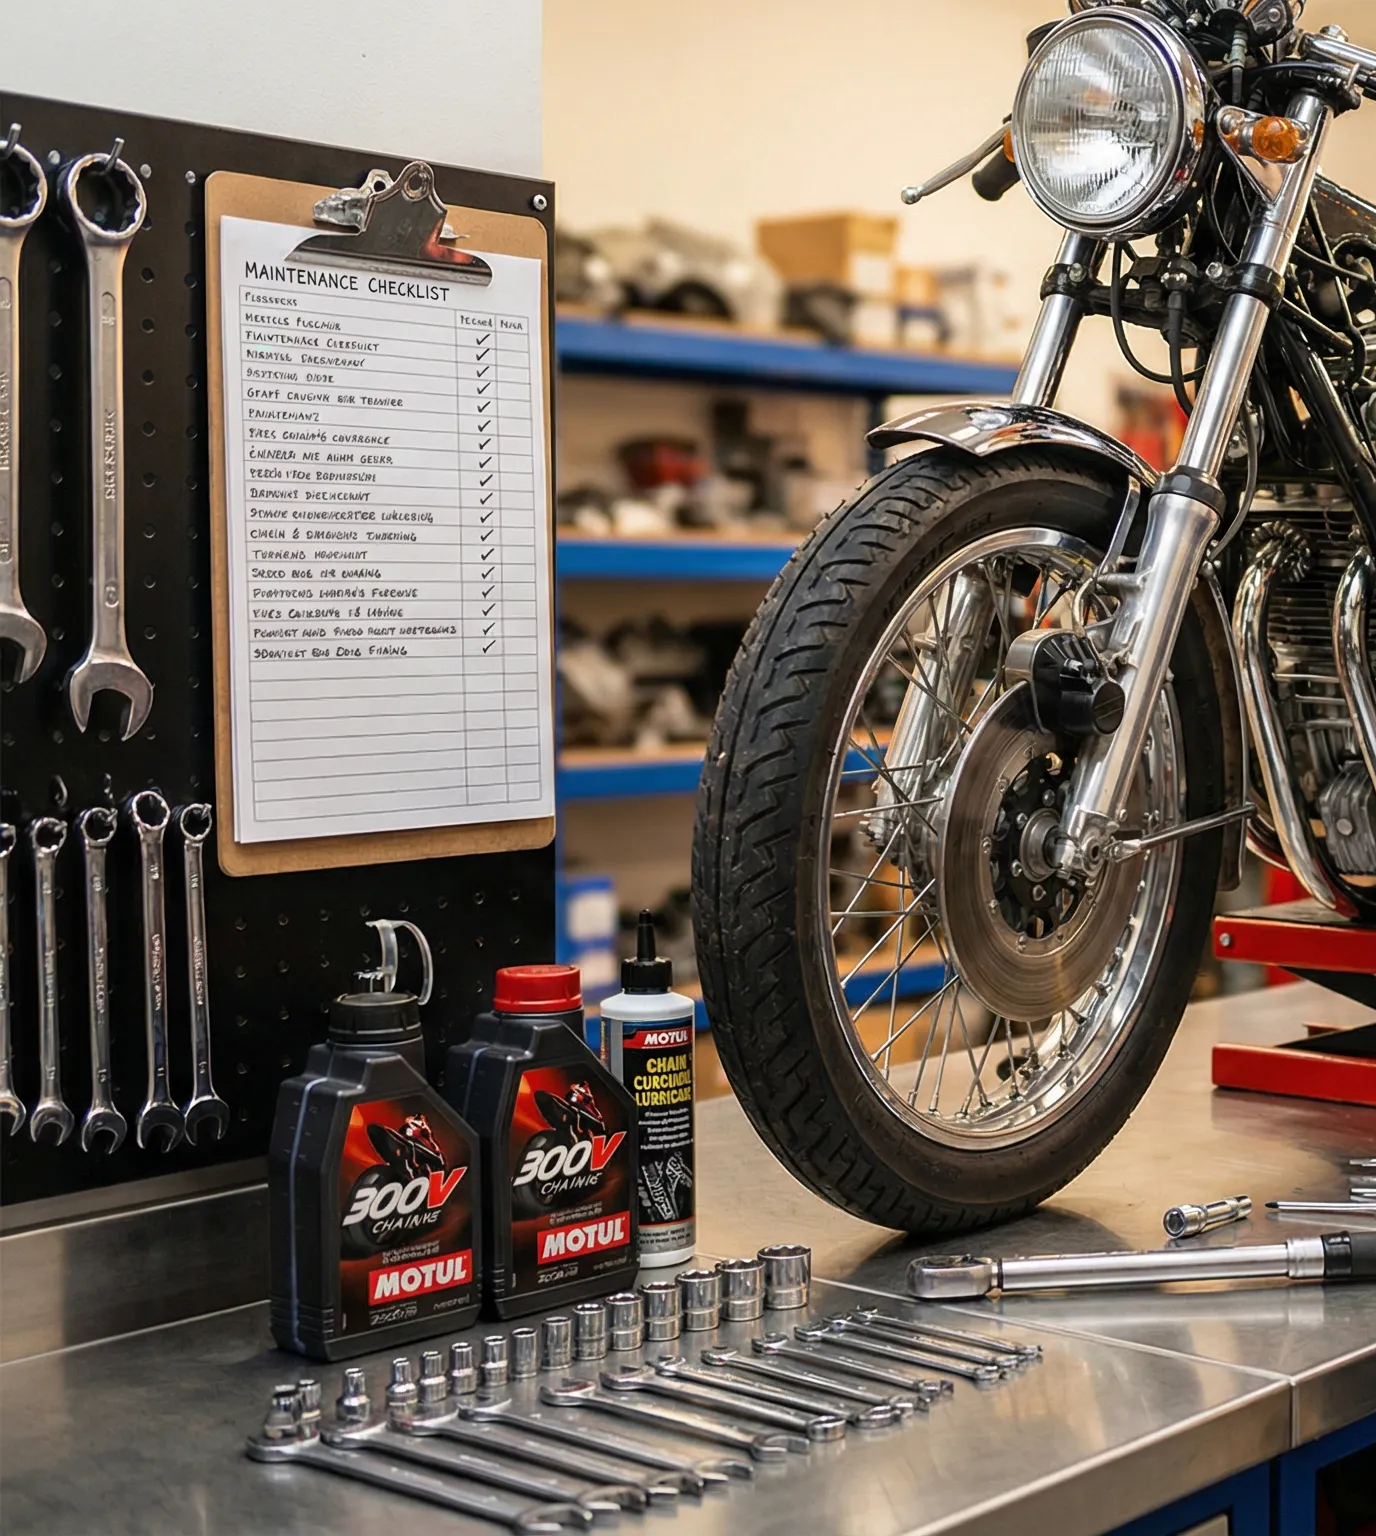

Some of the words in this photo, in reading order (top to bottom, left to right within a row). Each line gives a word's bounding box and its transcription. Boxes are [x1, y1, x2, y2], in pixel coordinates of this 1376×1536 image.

[245, 261, 359, 291] MAINTENANCE
[368, 277, 450, 301] CHECKLIST
[646, 1054, 687, 1073] CHAIN
[512, 1131, 627, 1187] 300V
[342, 1166, 468, 1226] 300V
[542, 1217, 624, 1259] MOTUL
[373, 1256, 467, 1300] MOTUL
